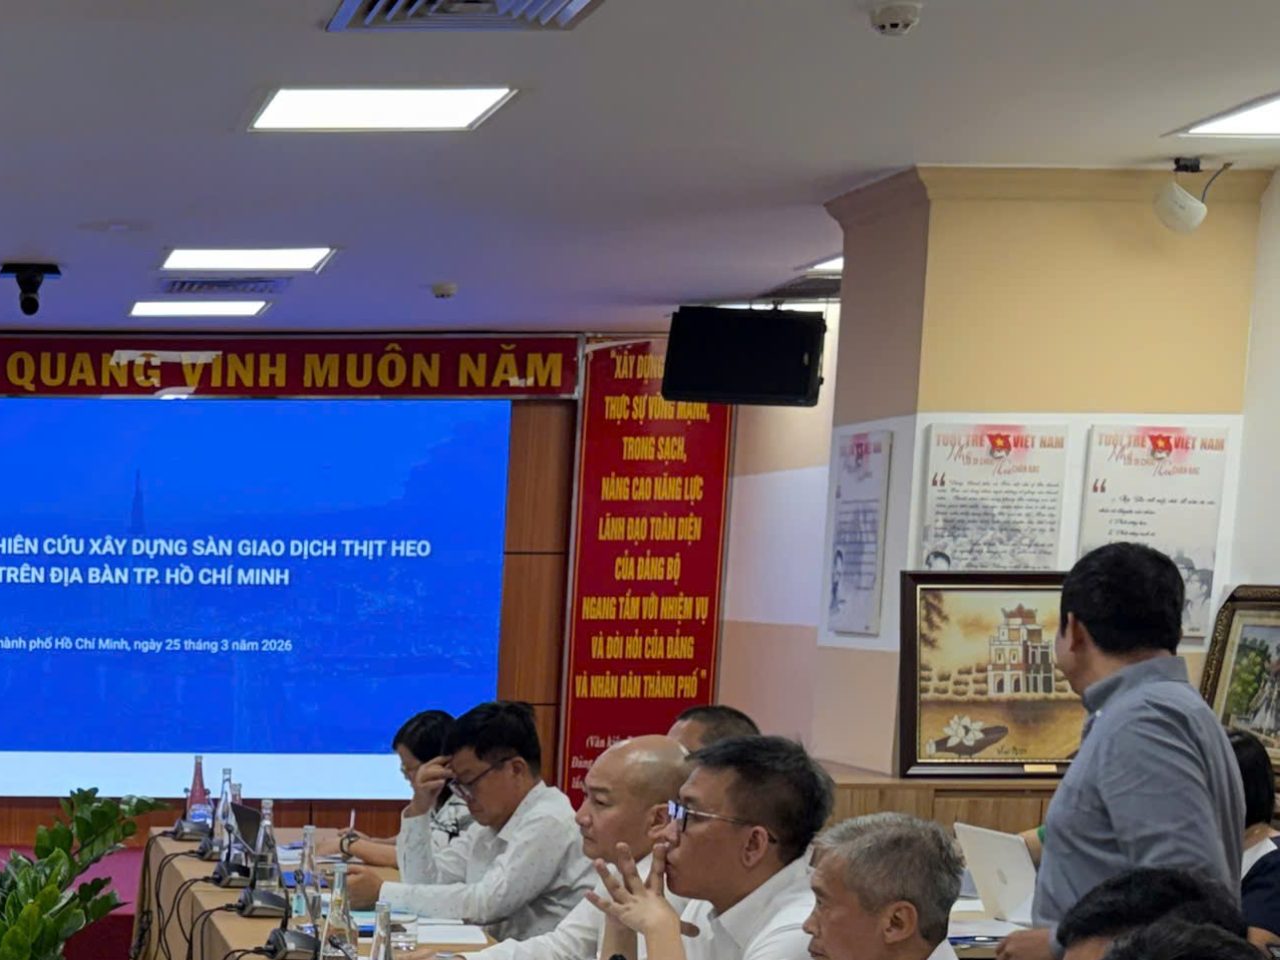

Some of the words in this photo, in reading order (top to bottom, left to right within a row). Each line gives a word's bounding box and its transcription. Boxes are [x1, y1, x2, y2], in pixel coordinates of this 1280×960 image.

[6, 351, 161, 391] QUANG
[181, 351, 286, 388] VINH
[303, 343, 440, 388] MUÔN
[458, 343, 563, 388] NĂM
[604, 394, 630, 425] THỰC
[632, 392, 648, 425] SỰ
[622, 436, 655, 460] TRONG
[657, 436, 687, 465] SẠCH,
[601, 471, 630, 500] NÂNG
[632, 477, 652, 500] CAO
[684, 474, 704, 506] LỰC
[598, 512, 626, 540] LÃNH
[627, 517, 647, 546] ĐẠO
[650, 512, 676, 540] TOÀN
[678, 512, 702, 546] DIỆN
[43, 535, 84, 555] CỨU
[89, 535, 127, 555] XÂY
[132, 537, 187, 559] DỰNG
[192, 536, 232, 556] SÀN
[237, 539, 285, 557] GIAO
[290, 539, 336, 560] DỊCH
[341, 539, 387, 560] THỊT
[391, 540, 431, 557] HEO
[49, 566, 83, 587] ĐỊA
[88, 564, 129, 584] BÀN
[133, 567, 160, 584] TP.
[165, 563, 194, 585] HỒ
[198, 564, 234, 585] CHÍ
[237, 568, 289, 585] MINH
[615, 549, 635, 580] CỦA
[637, 549, 665, 580] ĐẢNG
[666, 552, 681, 586] BỘ
[582, 596, 617, 620] NGANG
[660, 592, 693, 625] NHIỆM
[695, 596, 709, 625] VỤ
[29, 636, 53, 651] phố
[55, 637, 73, 649] Hồ
[75, 637, 96, 650] Chí
[98, 637, 131, 651] Minh,
[133, 639, 162, 652] ngày
[165, 639, 181, 650] 25
[184, 639, 218, 653] tháng
[221, 639, 229, 651] 3
[231, 639, 258, 651] năm
[261, 639, 292, 651] 2026
[591, 631, 604, 659] VÀ
[625, 629, 642, 659] HỎI
[644, 629, 664, 659] CỦA
[667, 629, 695, 659] ĐẢNG
[575, 671, 588, 698] VÀ
[590, 671, 618, 698] NHÂN
[621, 671, 641, 698] DÂN
[643, 671, 675, 698] THÀNH
